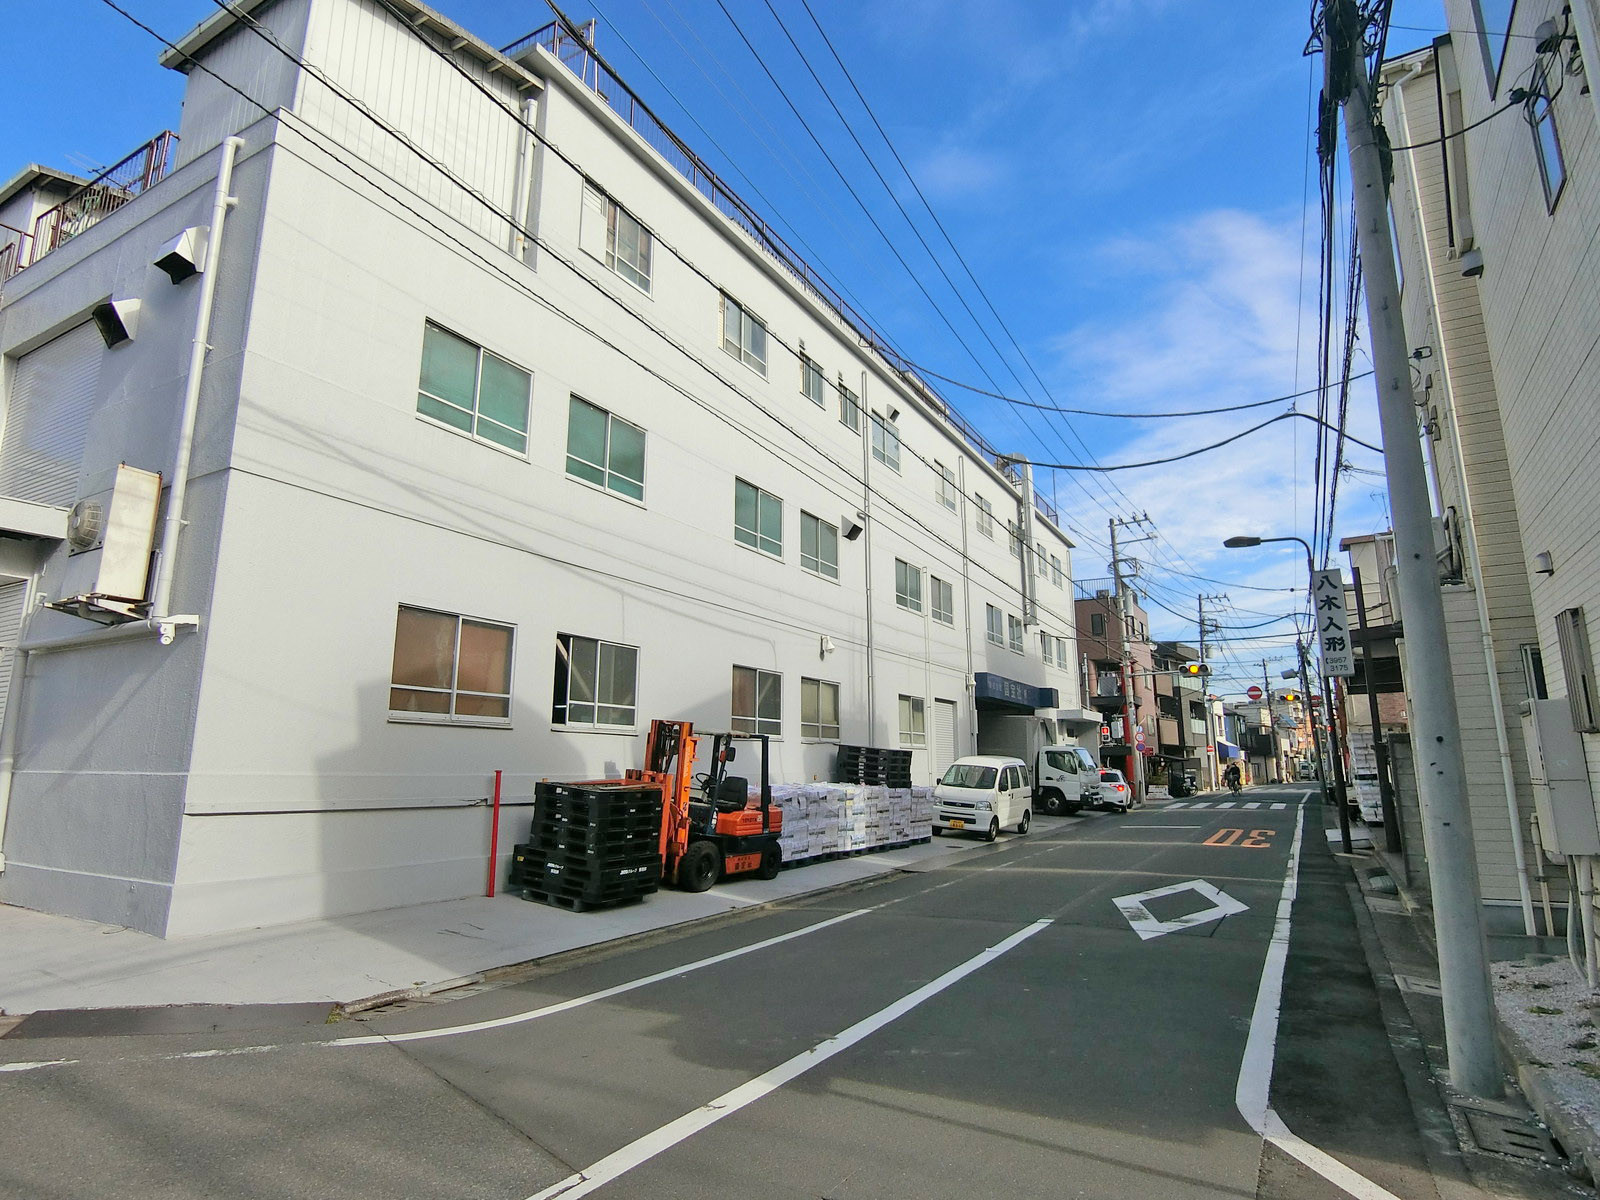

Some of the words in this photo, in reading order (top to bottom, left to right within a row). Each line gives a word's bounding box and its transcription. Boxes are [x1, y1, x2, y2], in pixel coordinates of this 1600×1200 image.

[1317, 575, 1345, 652] 八木人形
[1330, 664, 1348, 672] 3175
[1201, 828, 1276, 848] 30
